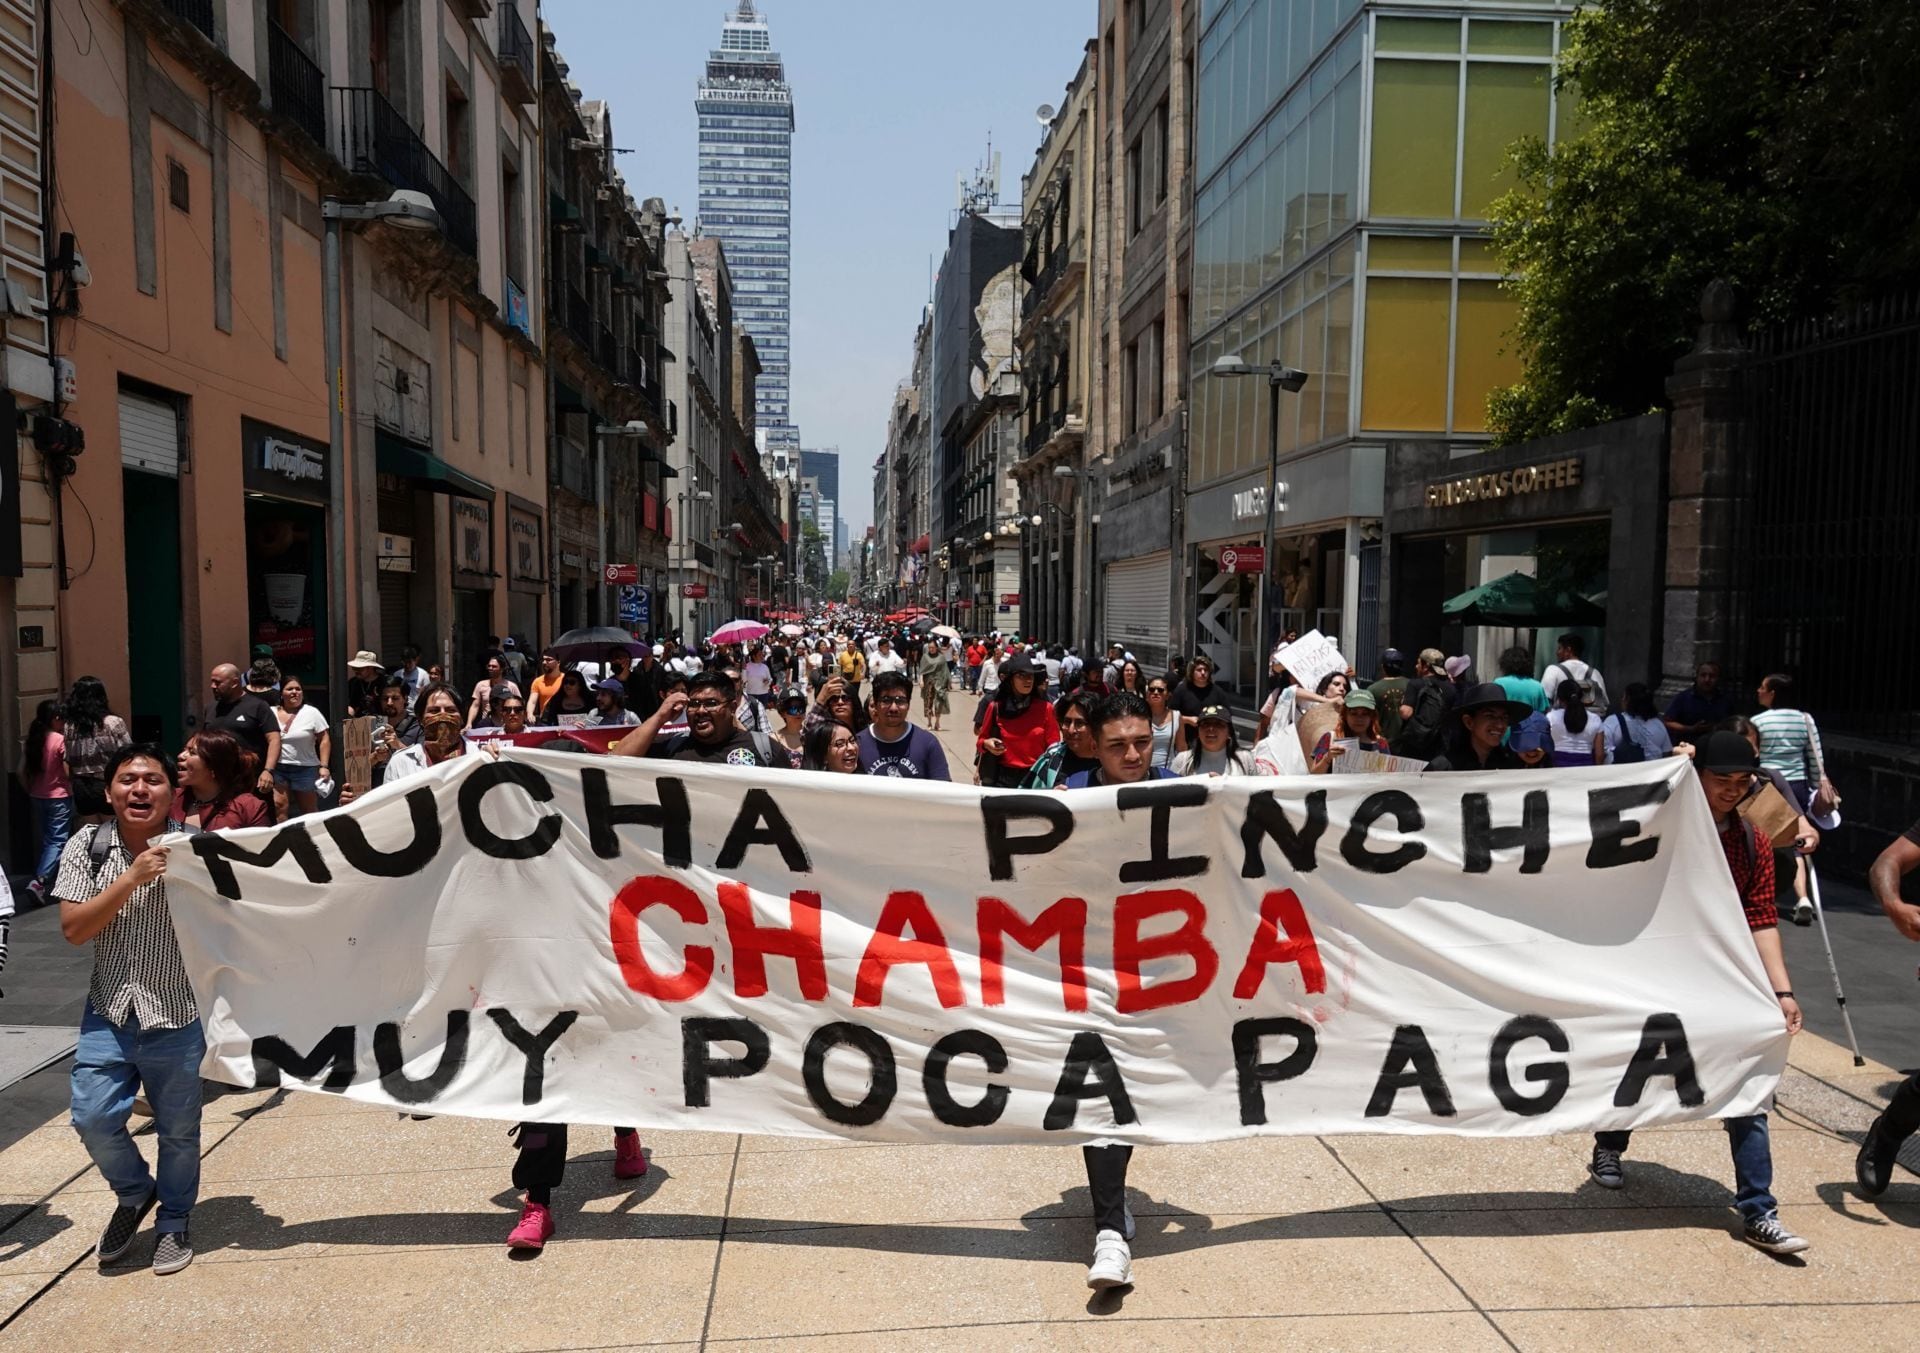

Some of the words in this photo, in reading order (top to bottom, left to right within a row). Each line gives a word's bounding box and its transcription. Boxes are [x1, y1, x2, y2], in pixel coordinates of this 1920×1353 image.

[702, 91, 786, 101] LATINOAMERICANA
[1425, 472, 1509, 508] STARBUCKS
[1512, 458, 1581, 494] COFFEE
[620, 603, 636, 612] WC
[191, 761, 812, 900] MUCHA
[983, 778, 1671, 883] PINCHE
[609, 876, 1326, 1013] CHAMBA
[251, 1008, 578, 1105] MUY
[682, 1016, 1137, 1131] POCA
[1231, 1012, 1706, 1126] PAGA
